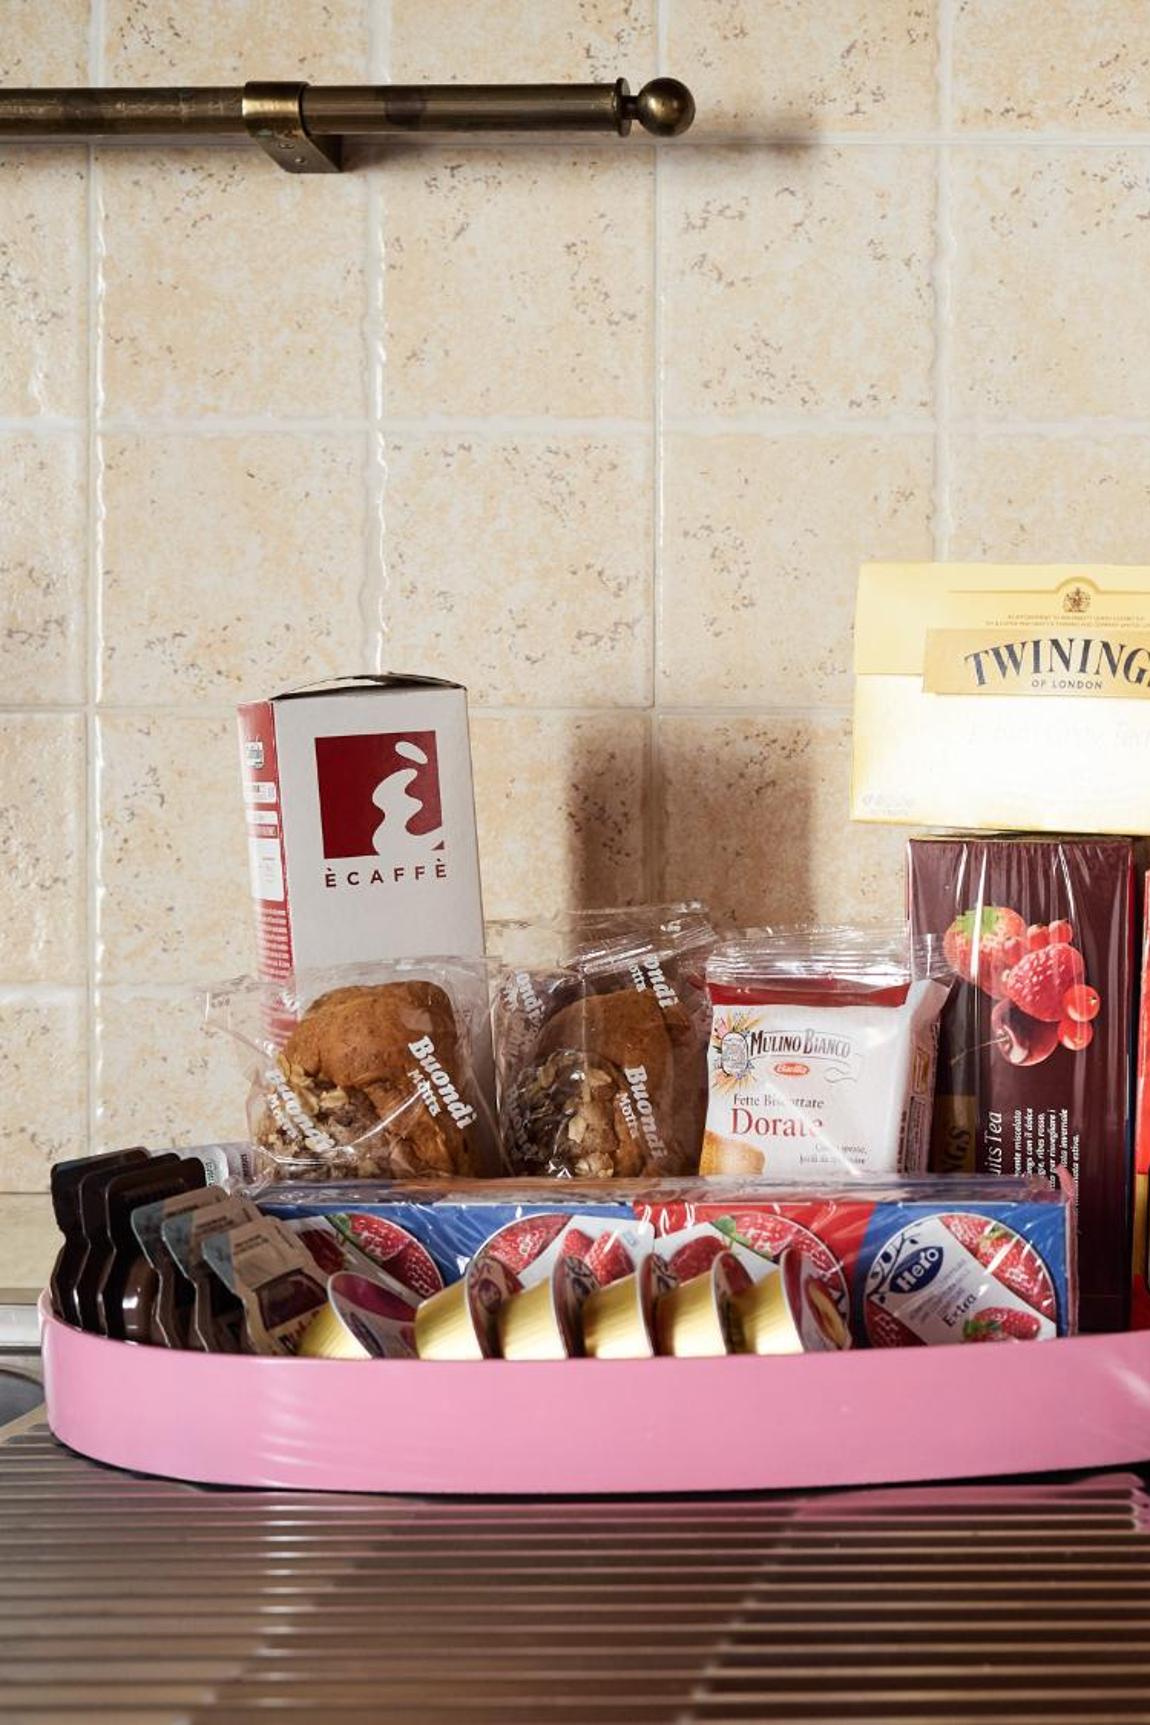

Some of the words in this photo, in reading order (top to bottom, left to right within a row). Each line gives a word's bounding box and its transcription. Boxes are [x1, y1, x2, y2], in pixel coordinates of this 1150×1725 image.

[1031, 680, 1045, 689] OF
[1052, 680, 1103, 690] LONDON
[325, 858, 447, 888] ÈCAFFÈ
[734, 1093, 760, 1106] Fette
[984, 1111, 1002, 1143] Tea
[896, 1248, 940, 1291] Hero
[942, 1293, 977, 1328] Extra
